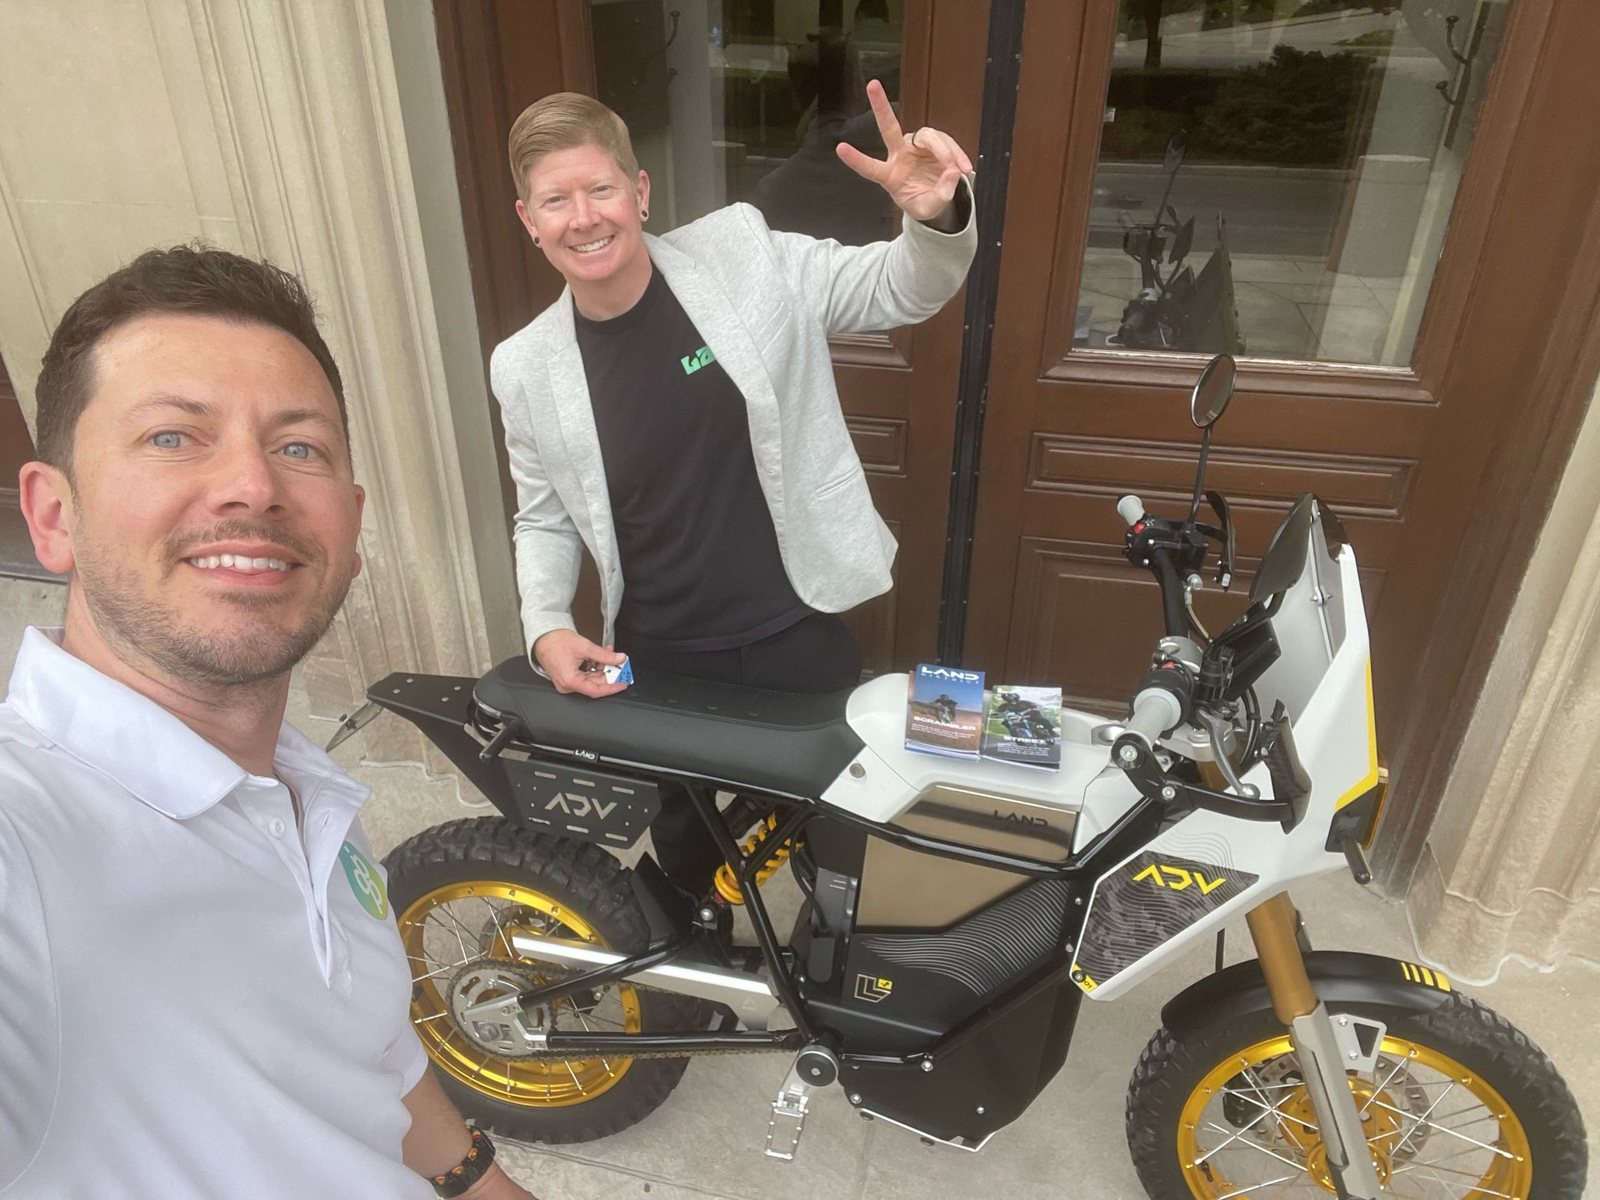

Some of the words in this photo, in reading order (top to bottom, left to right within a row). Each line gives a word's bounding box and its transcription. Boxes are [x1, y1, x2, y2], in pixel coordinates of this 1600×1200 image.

[921, 666, 980, 681] LAND
[574, 749, 595, 760] LAND
[544, 792, 618, 820] ADV
[994, 809, 1049, 827] LAND
[1132, 864, 1227, 895] ADV
